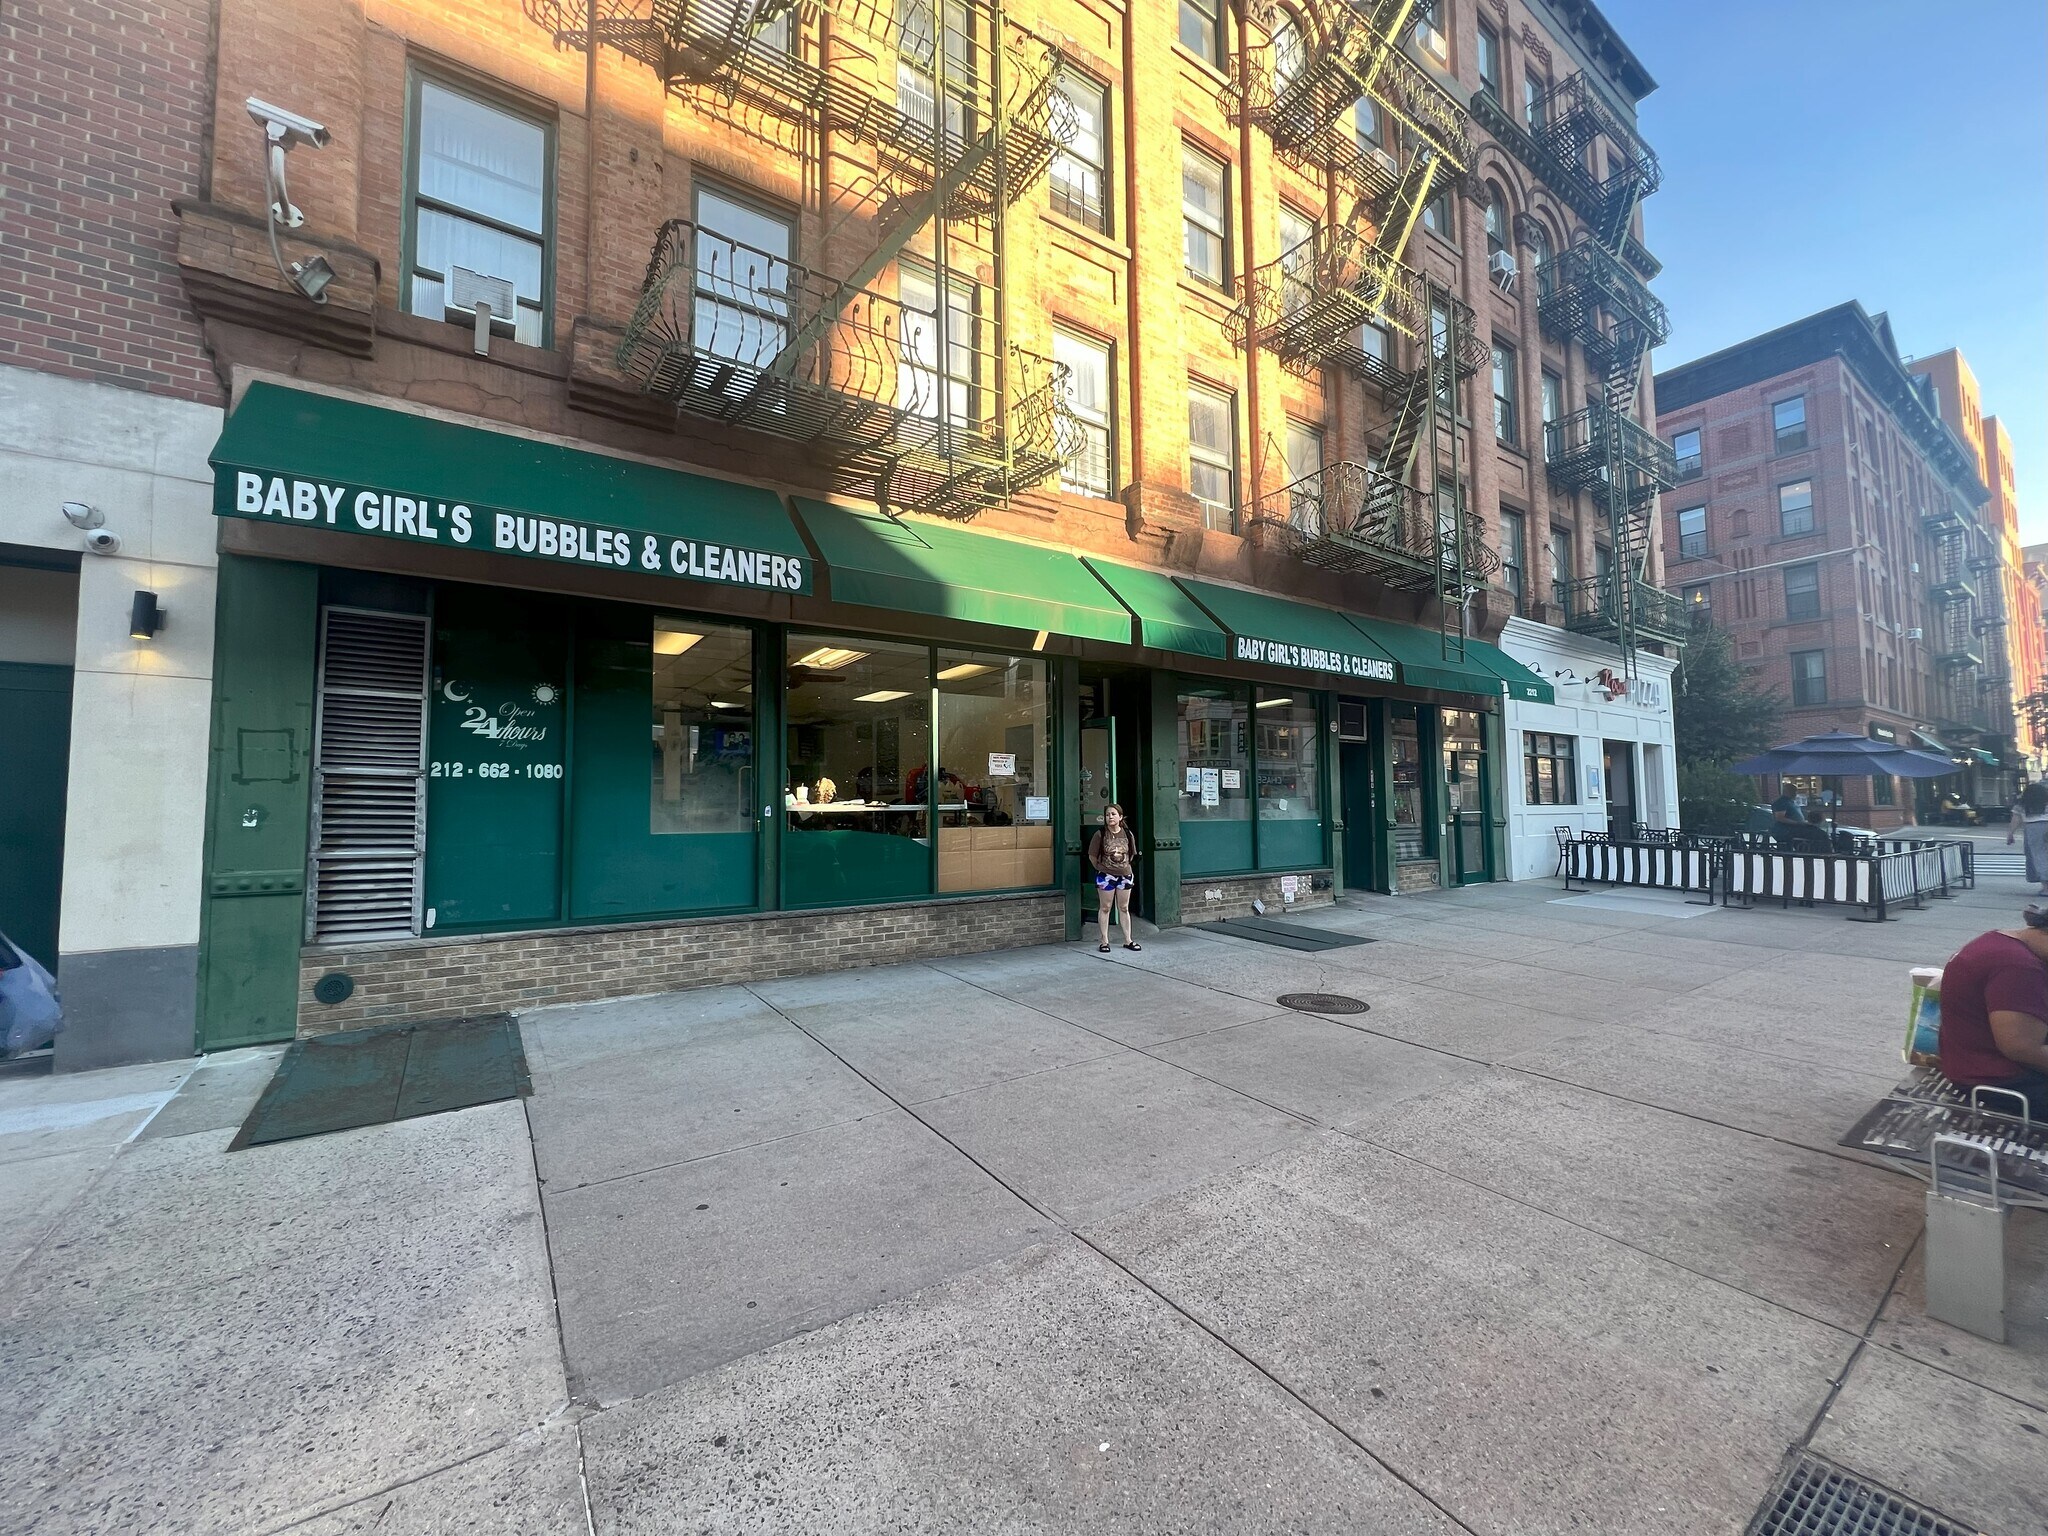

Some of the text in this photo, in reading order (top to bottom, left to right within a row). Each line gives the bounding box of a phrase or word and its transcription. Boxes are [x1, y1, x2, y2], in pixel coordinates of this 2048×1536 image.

[236, 471, 803, 590] BABY GIRL'S BUBBLES & CLEANERS
[1237, 637, 1393, 681] BABY GIRL'S BUBBLES & CLEANERS
[1626, 678, 1660, 707] PIZZA
[460, 706, 548, 741] 24 hours
[498, 701, 536, 721] Open
